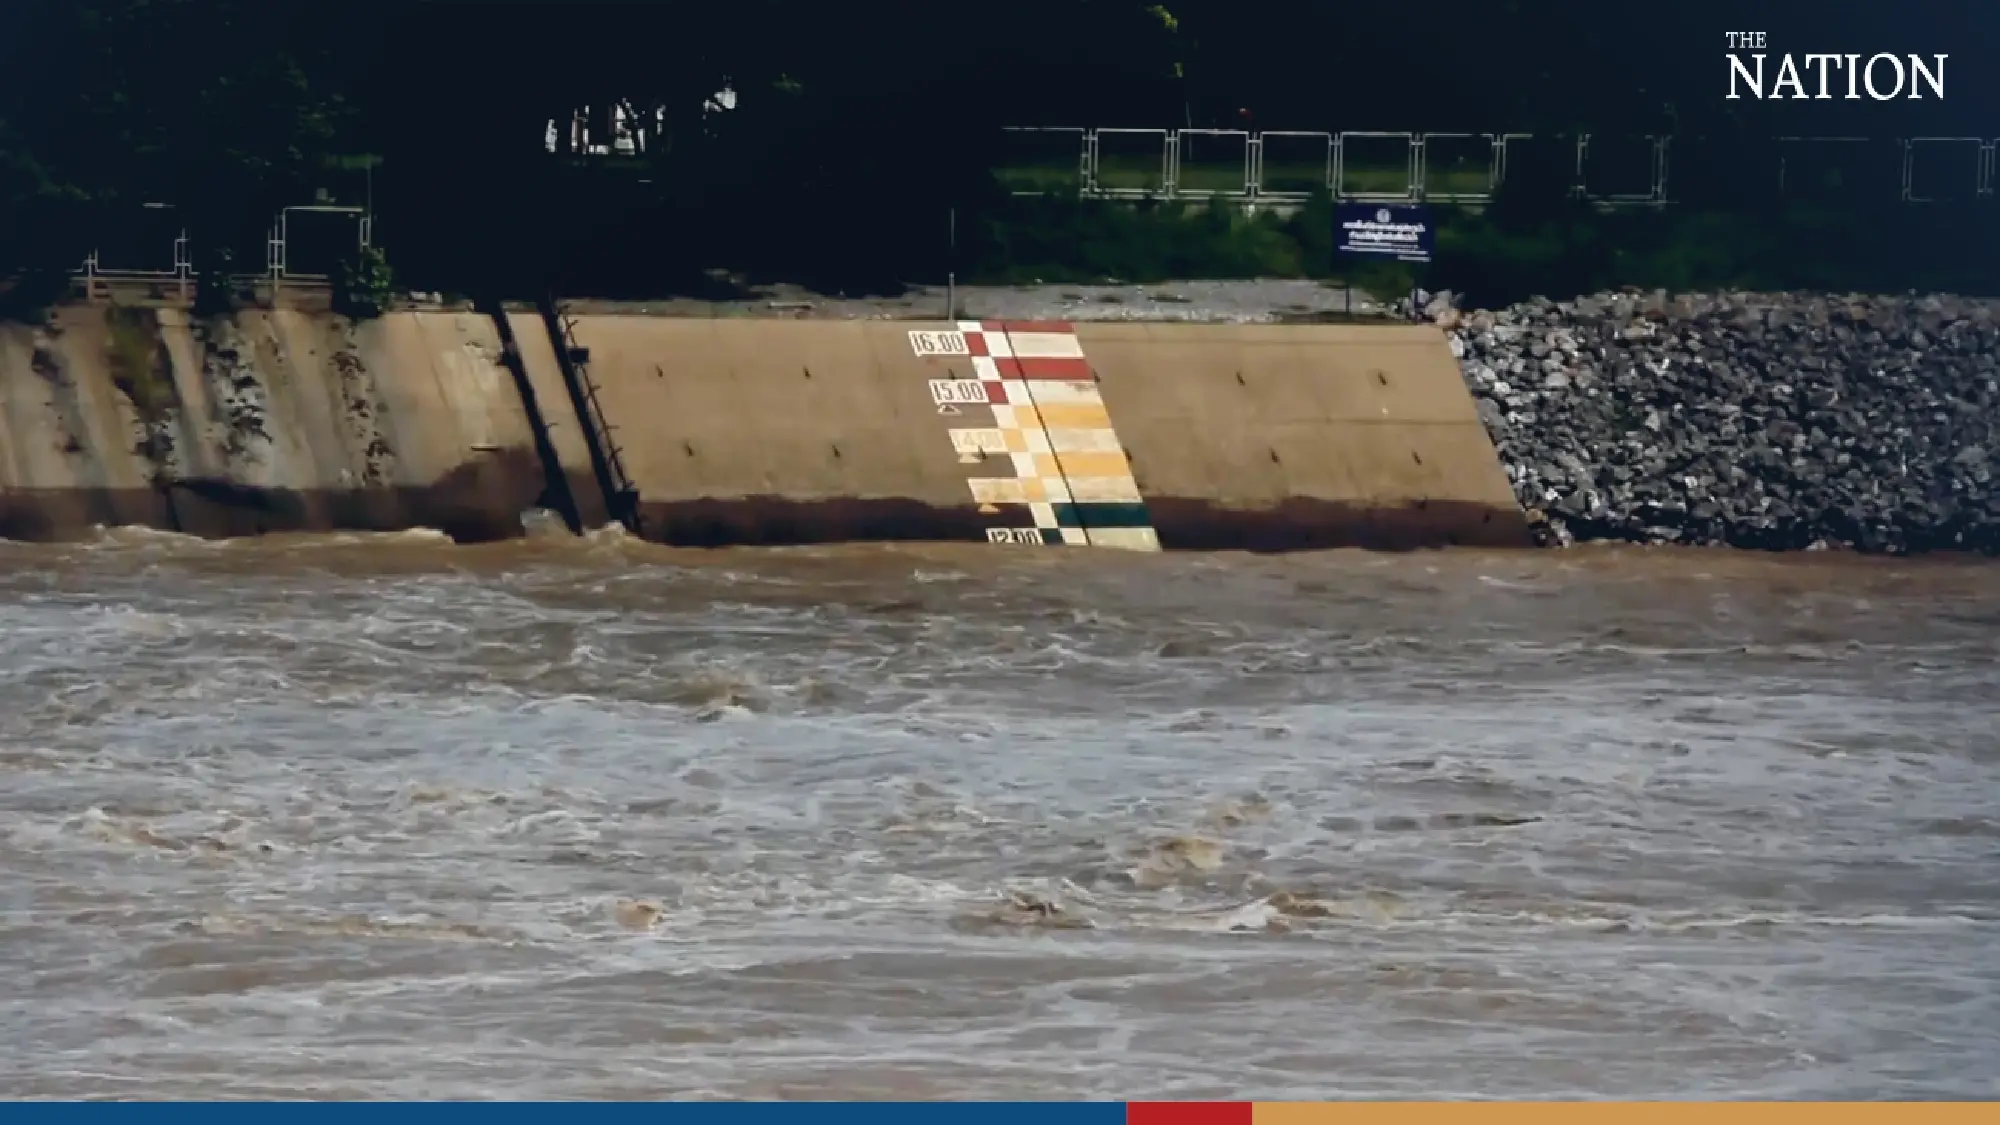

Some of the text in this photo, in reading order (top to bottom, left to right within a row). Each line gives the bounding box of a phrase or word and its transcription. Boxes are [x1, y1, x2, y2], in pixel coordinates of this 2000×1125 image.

[911, 333, 963, 352] 16.00
[931, 382, 983, 400] 15.00
[991, 531, 1038, 544] 1200
